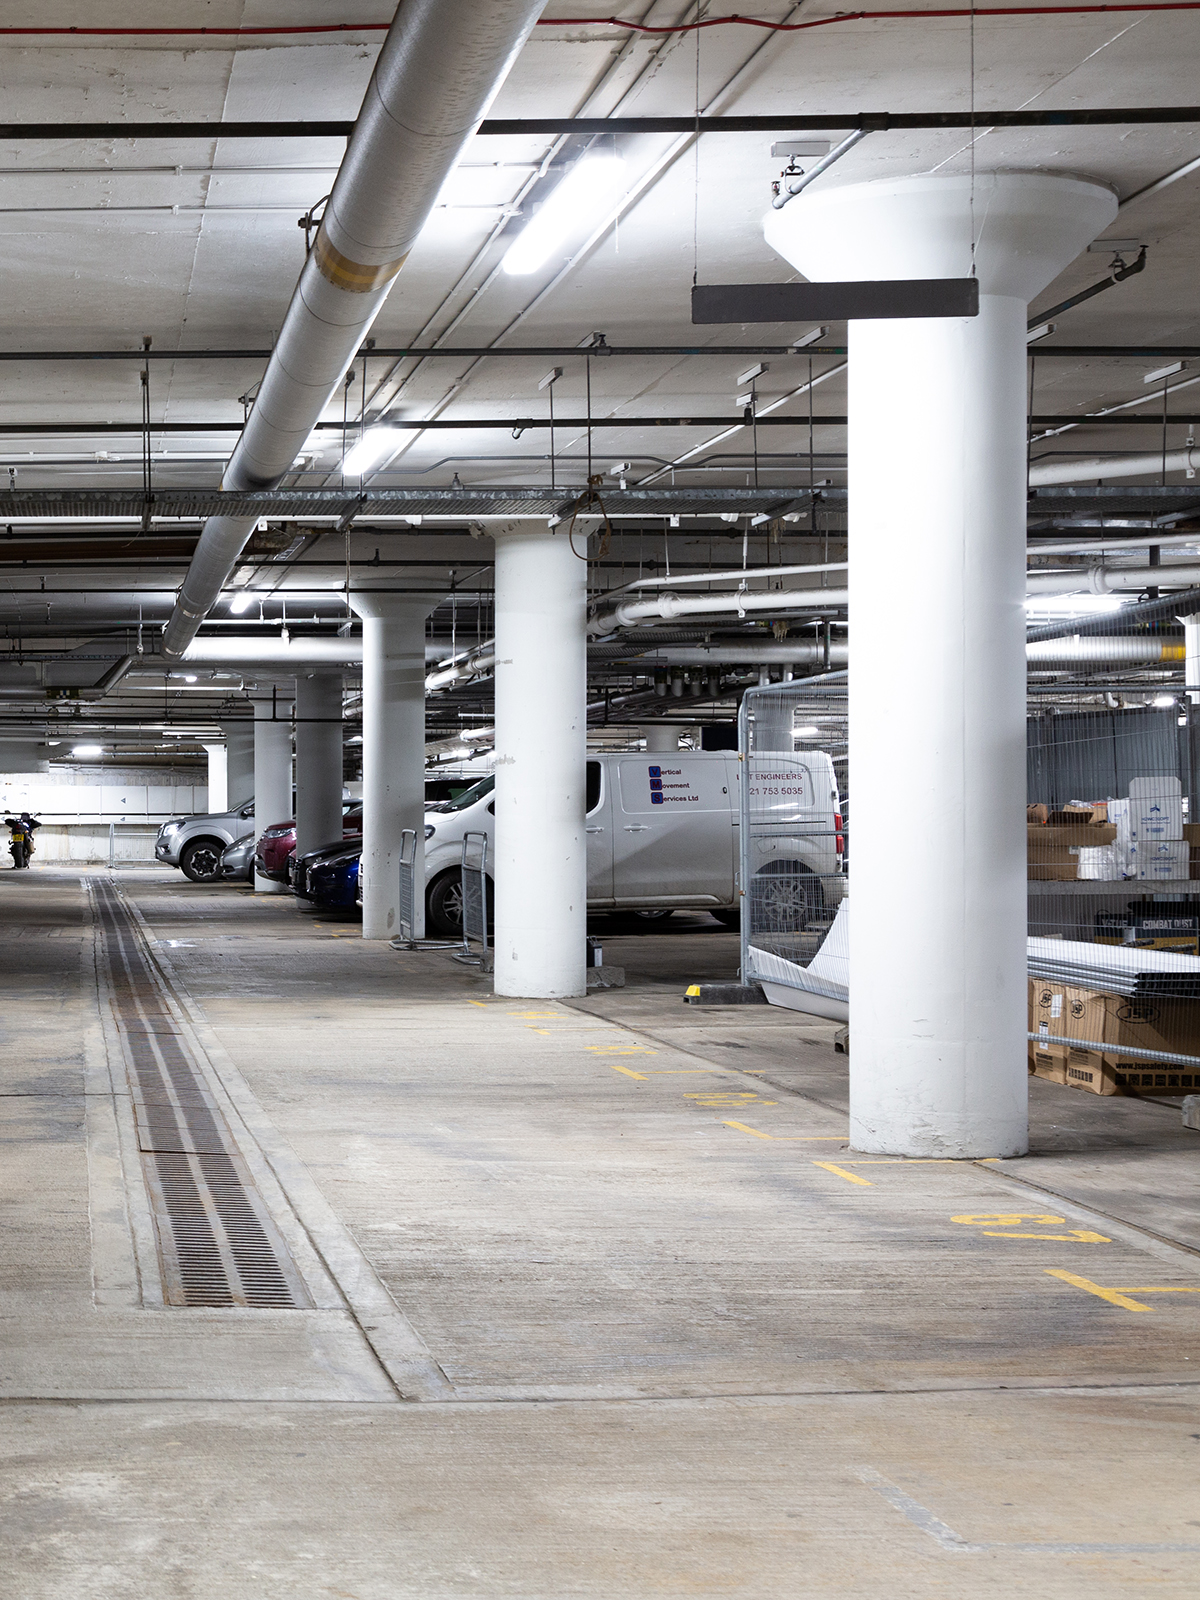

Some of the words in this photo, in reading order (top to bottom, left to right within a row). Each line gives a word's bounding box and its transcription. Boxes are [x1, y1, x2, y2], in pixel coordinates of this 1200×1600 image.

[650, 767, 682, 776] Vertical
[651, 780, 690, 789] Movement
[762, 787, 779, 795] 753
[781, 787, 803, 795] 5035
[653, 794, 687, 803] Services
[1143, 920, 1173, 930] COMBAT
[1174, 919, 1193, 928] DUST
[1124, 1007, 1154, 1019] JSP
[1115, 1062, 1185, 1071] www.jspsafety.com
[682, 1092, 778, 1107] 66
